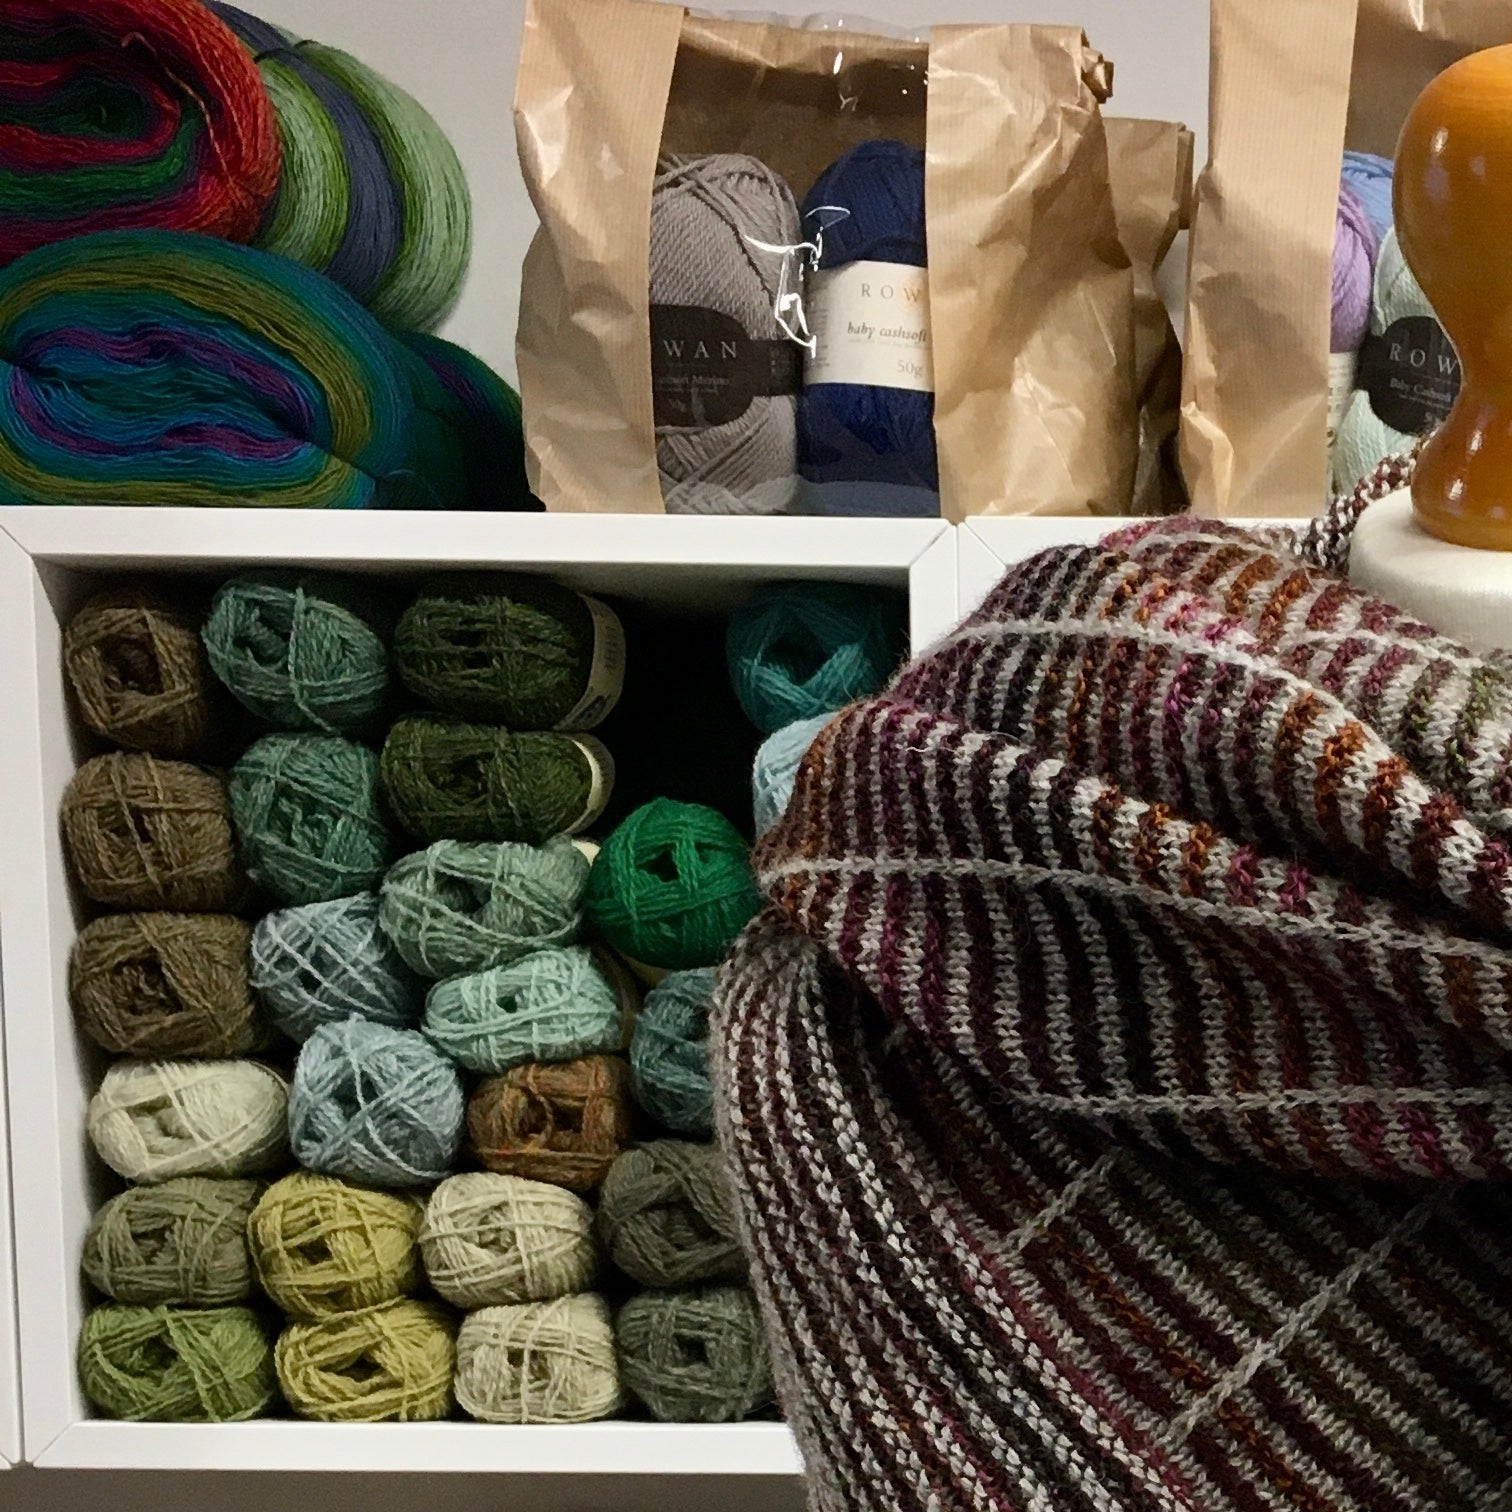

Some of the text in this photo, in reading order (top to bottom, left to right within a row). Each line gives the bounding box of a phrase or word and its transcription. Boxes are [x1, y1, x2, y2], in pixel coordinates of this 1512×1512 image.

[861, 283, 922, 303] ROW
[847, 321, 876, 340] baby
[663, 339, 738, 359] WAN
[1389, 343, 1457, 375] ROW
[897, 359, 924, 378] 50g
